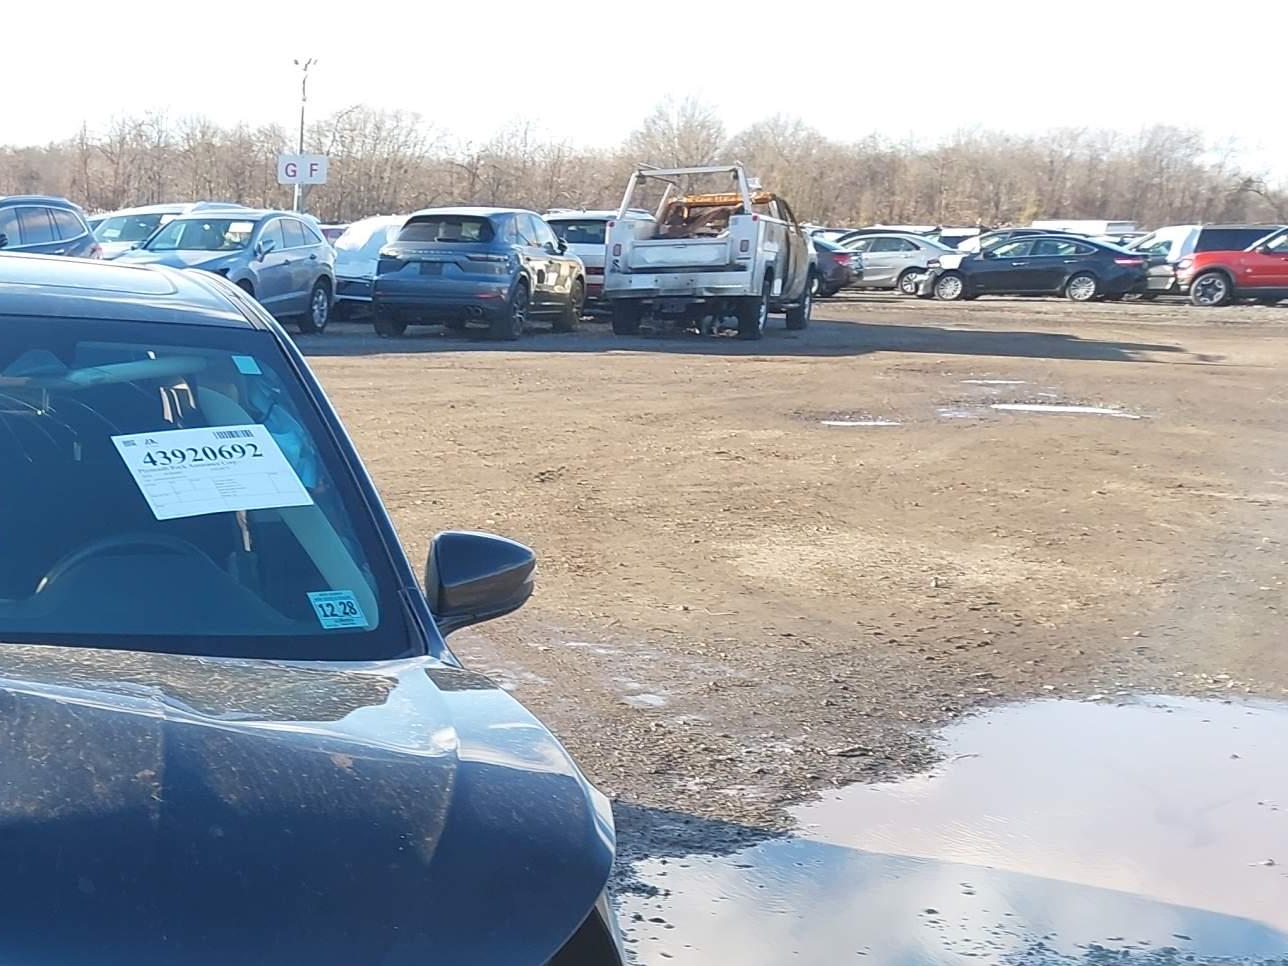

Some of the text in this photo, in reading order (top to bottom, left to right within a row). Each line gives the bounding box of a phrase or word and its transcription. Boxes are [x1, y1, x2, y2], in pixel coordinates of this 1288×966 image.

[285, 163, 319, 177] G F
[142, 443, 263, 466] 43920692
